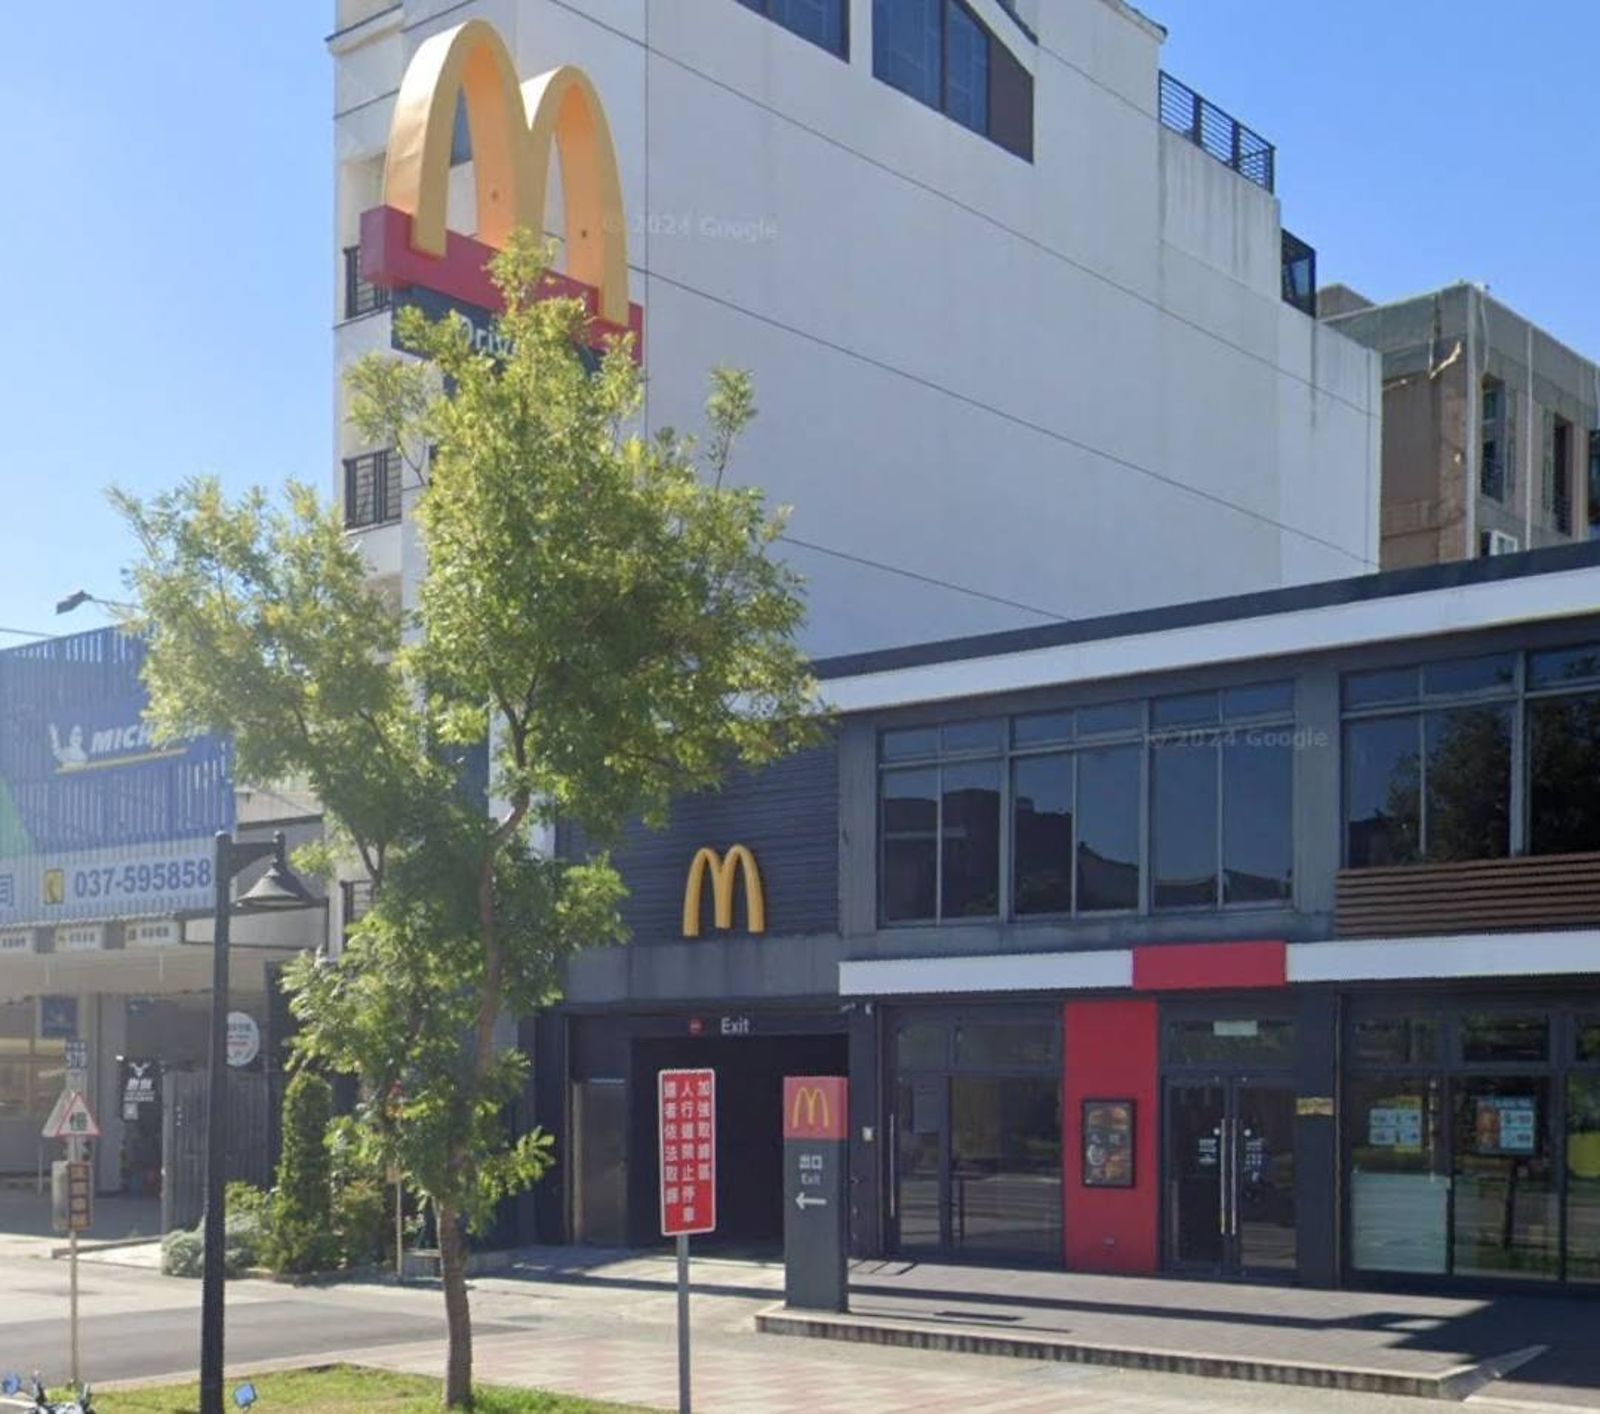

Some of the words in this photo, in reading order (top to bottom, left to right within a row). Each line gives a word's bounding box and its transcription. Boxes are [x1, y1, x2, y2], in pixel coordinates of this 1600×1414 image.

[455, 312, 519, 359] Driv
[75, 858, 212, 898] 037-595858
[721, 1017, 749, 1035] Exit
[799, 1154, 823, 1170] 出口
[801, 1173, 821, 1185] Exit
